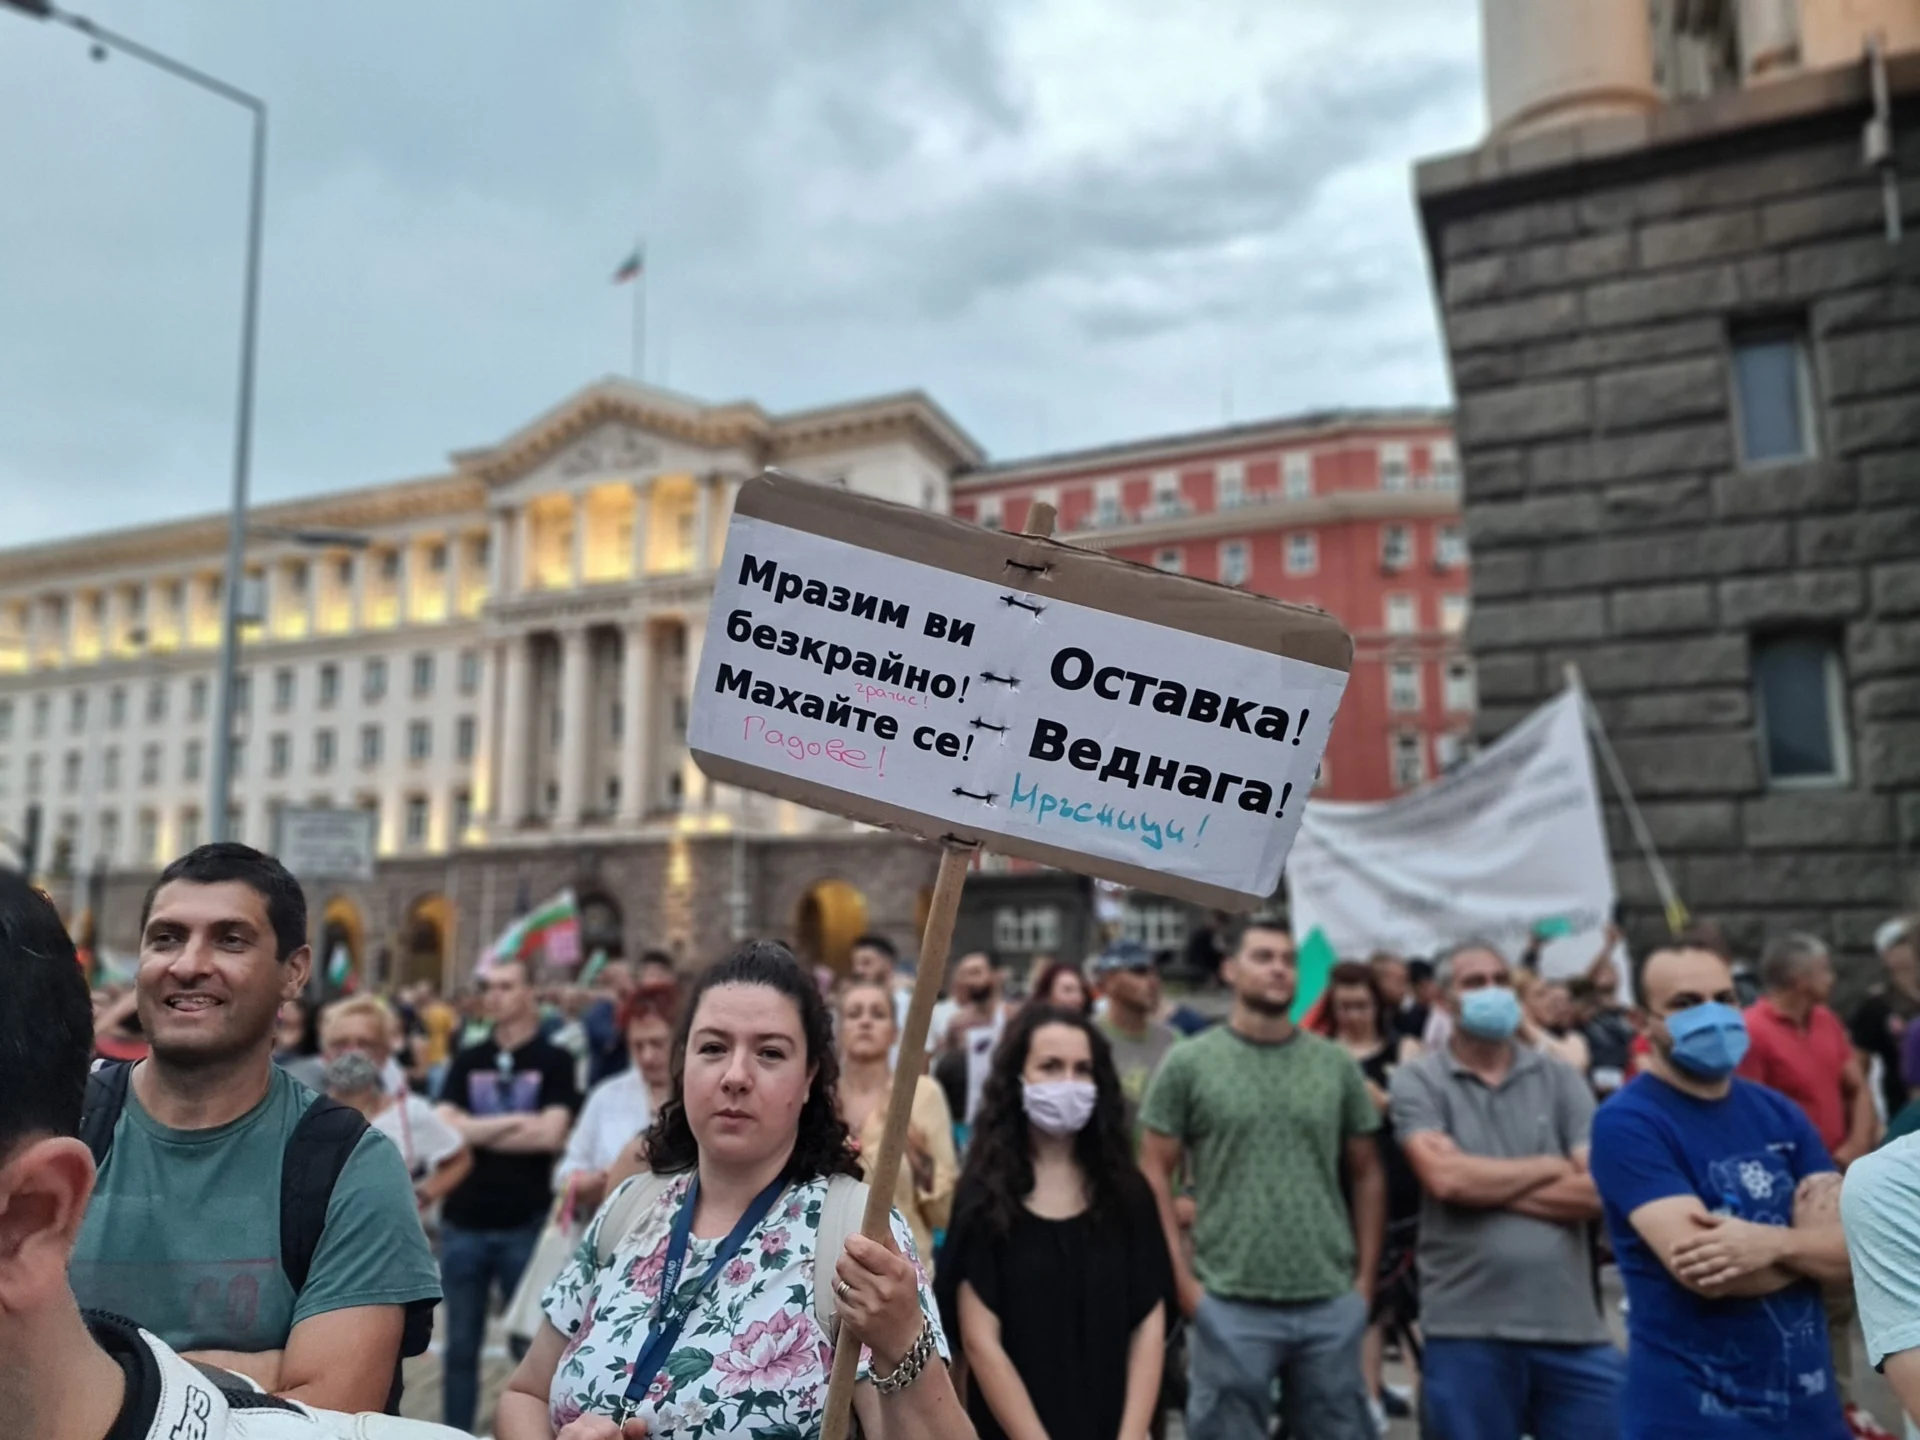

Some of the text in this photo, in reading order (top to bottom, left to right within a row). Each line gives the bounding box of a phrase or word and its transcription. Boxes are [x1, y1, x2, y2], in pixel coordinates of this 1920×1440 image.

[738, 553, 911, 630] Мразим
[922, 610, 977, 649] ви
[726, 609, 970, 704] безкрайно!
[854, 682, 928, 709] гратис!
[1049, 646, 1310, 747] Оставка!
[714, 662, 975, 762] Махайте се!
[743, 715, 887, 778] Гадове!
[1010, 771, 1211, 850] Мръсници!
[1028, 717, 1293, 819] Веднага!
